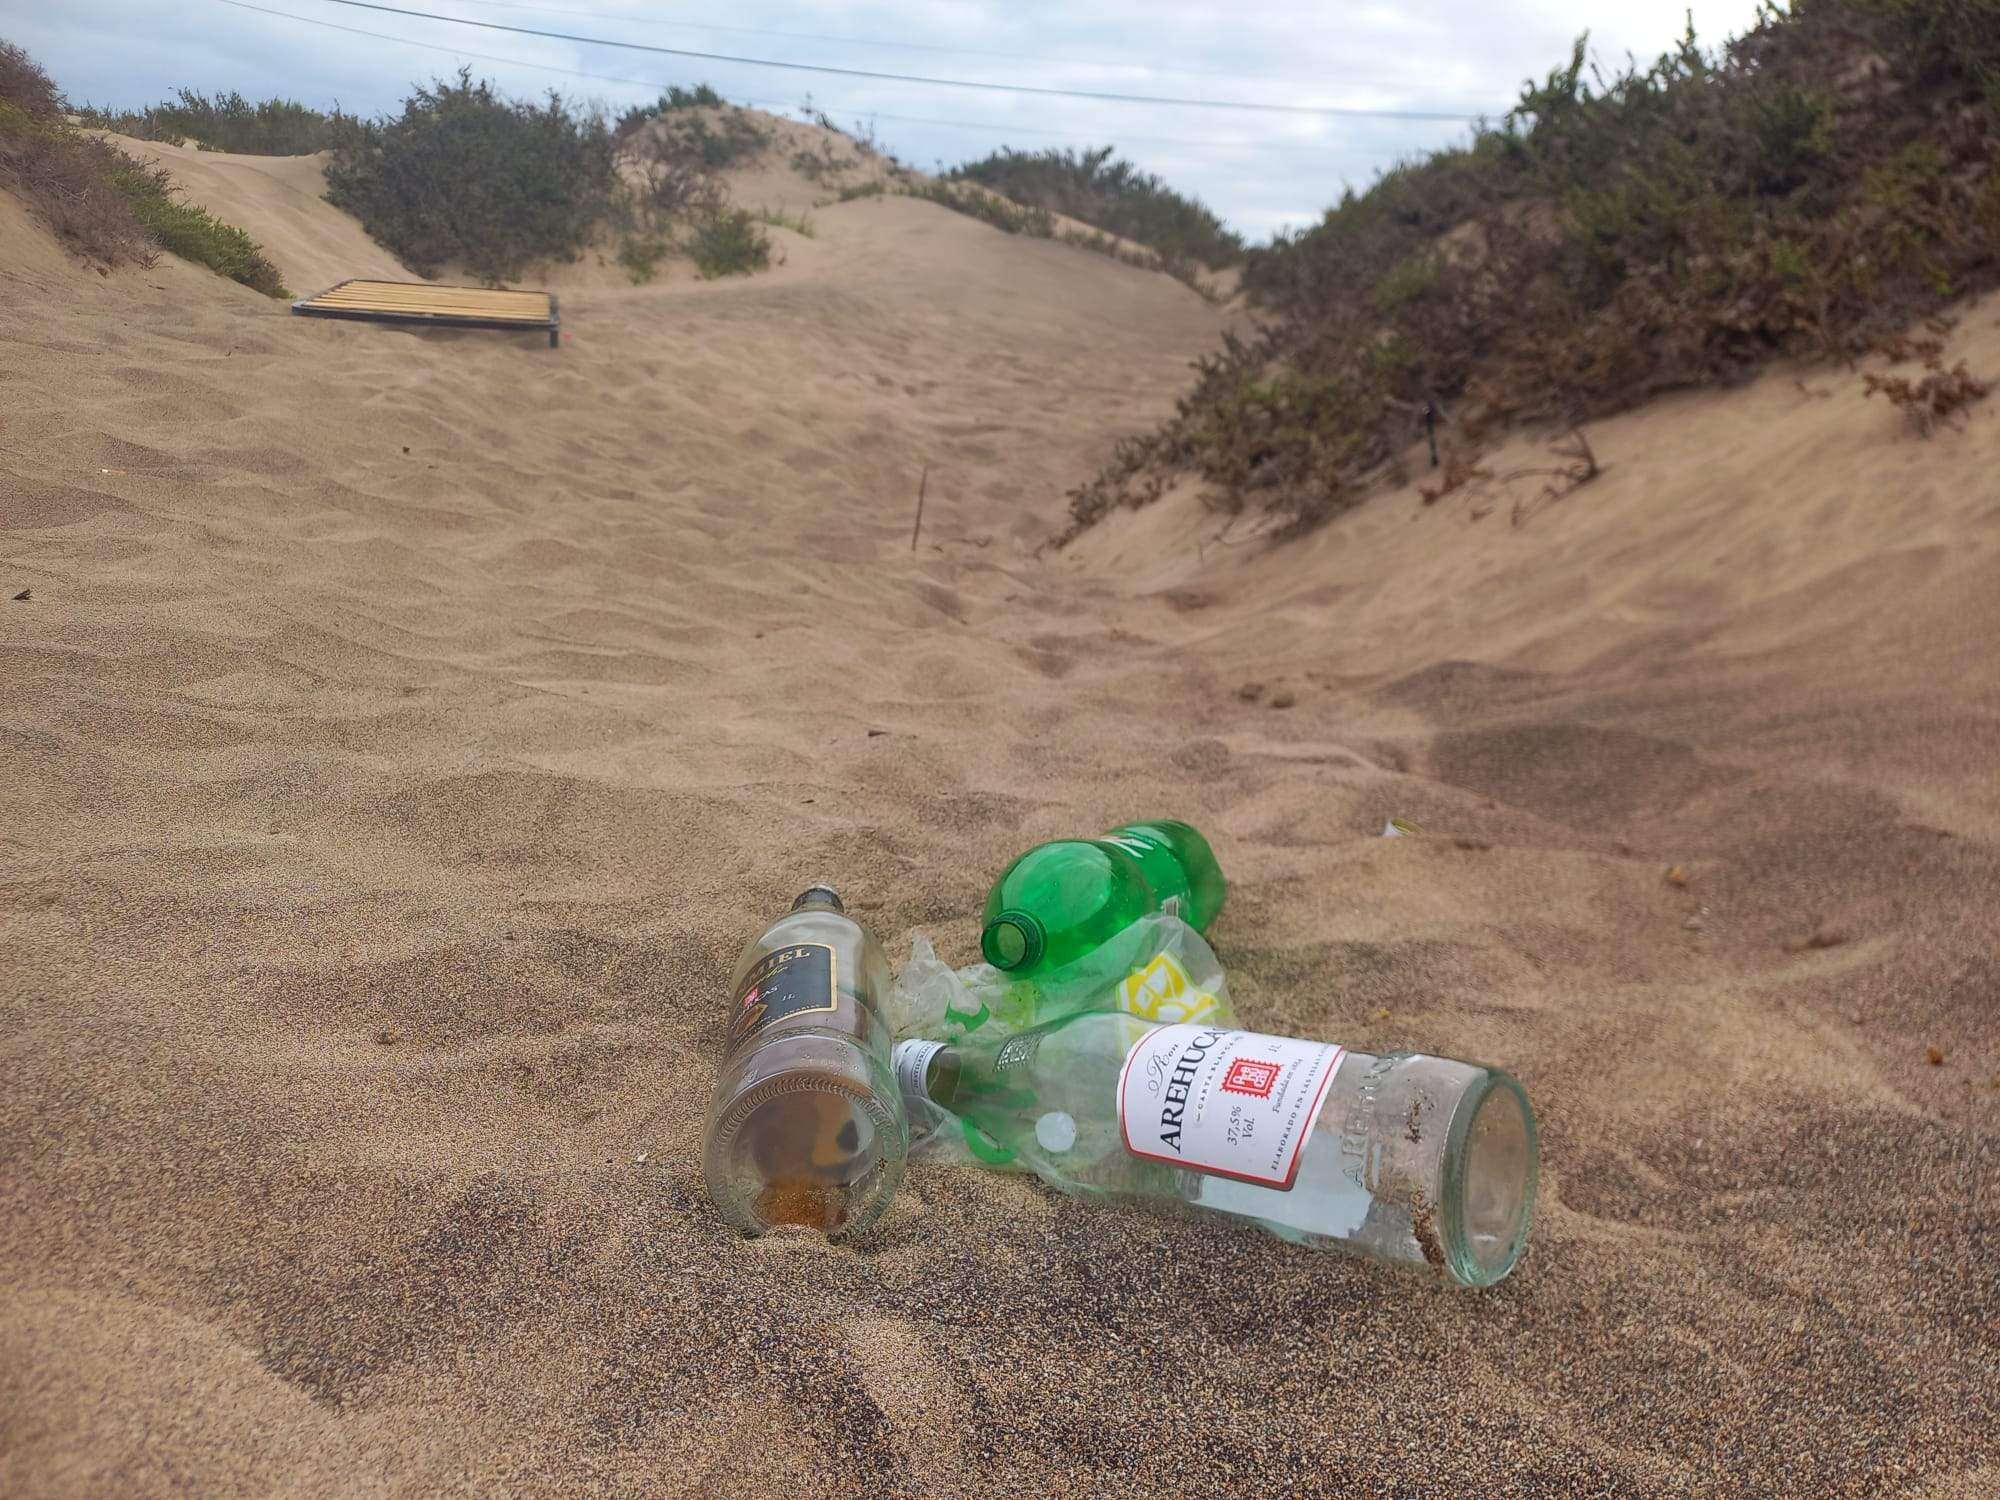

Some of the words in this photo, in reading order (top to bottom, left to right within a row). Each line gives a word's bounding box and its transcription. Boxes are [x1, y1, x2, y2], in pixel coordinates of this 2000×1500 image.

[1147, 1043, 1179, 1098] Ron
[1160, 1028, 1230, 1154] AREHUCA
[1227, 1106, 1242, 1146] 37,5%
[1243, 1117, 1255, 1139] Vol.
[1271, 1112, 1297, 1171] ELABORADO
